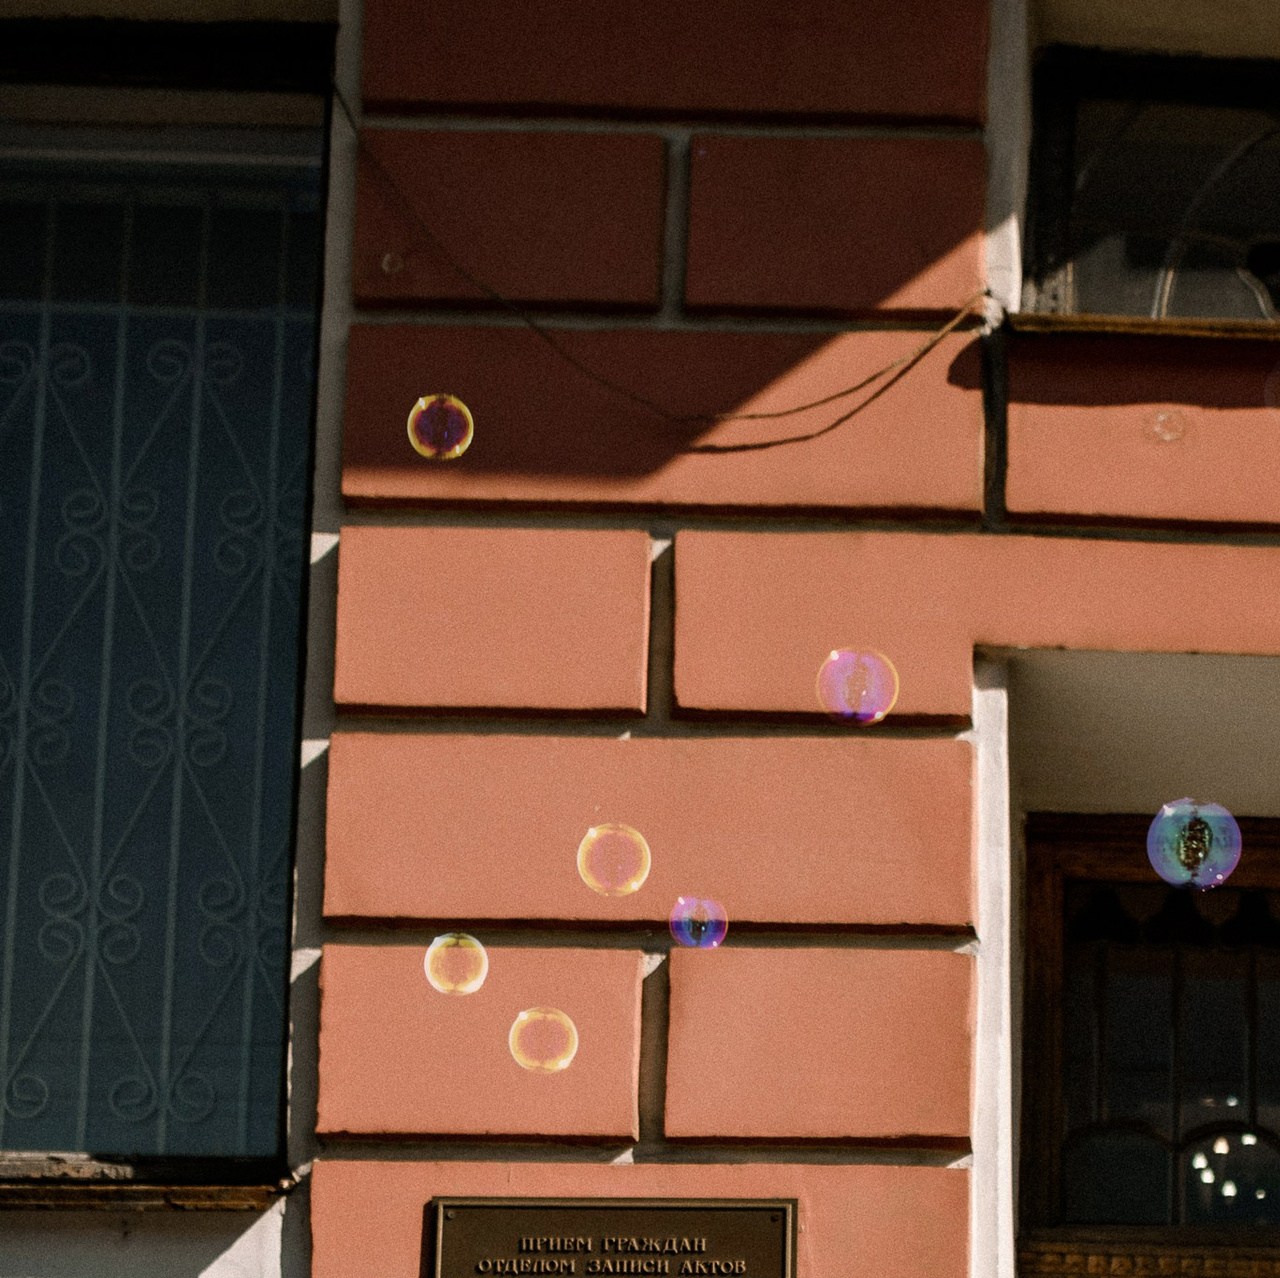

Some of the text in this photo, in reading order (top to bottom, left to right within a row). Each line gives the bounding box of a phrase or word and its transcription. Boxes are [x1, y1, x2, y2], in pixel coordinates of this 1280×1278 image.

[519, 1237, 706, 1253] ПРИЕМ ГРАЖДАН
[477, 1259, 746, 1275] ОТДЕЛОМ ЗАПИСИ АКТОВ
